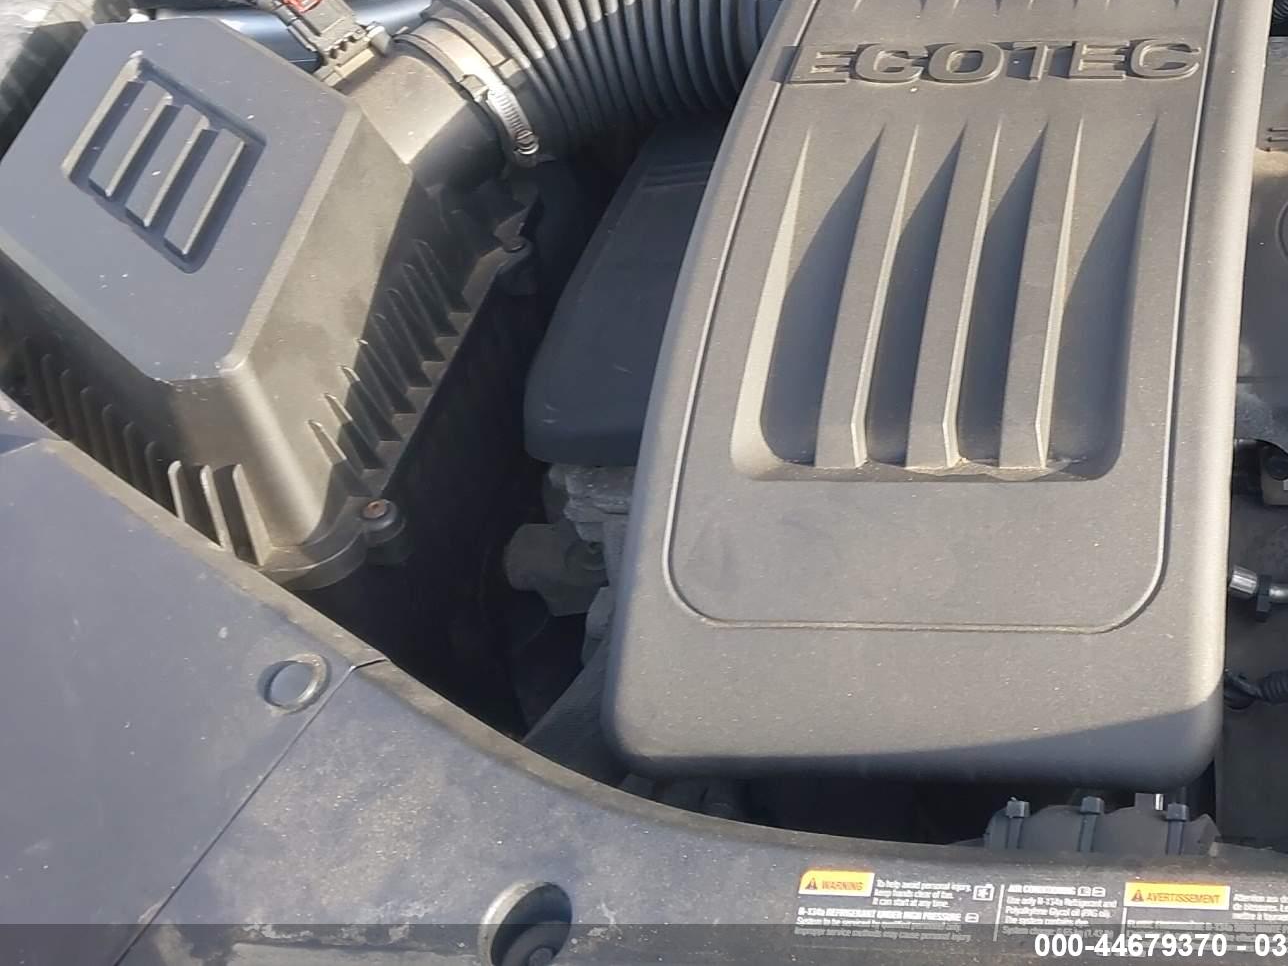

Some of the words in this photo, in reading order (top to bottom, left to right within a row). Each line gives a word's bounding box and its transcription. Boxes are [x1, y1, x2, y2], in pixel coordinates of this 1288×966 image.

[786, 38, 1202, 84] ECOTEC
[822, 880, 864, 891] WARNING
[1147, 892, 1220, 904] AVERTISSEMENT
